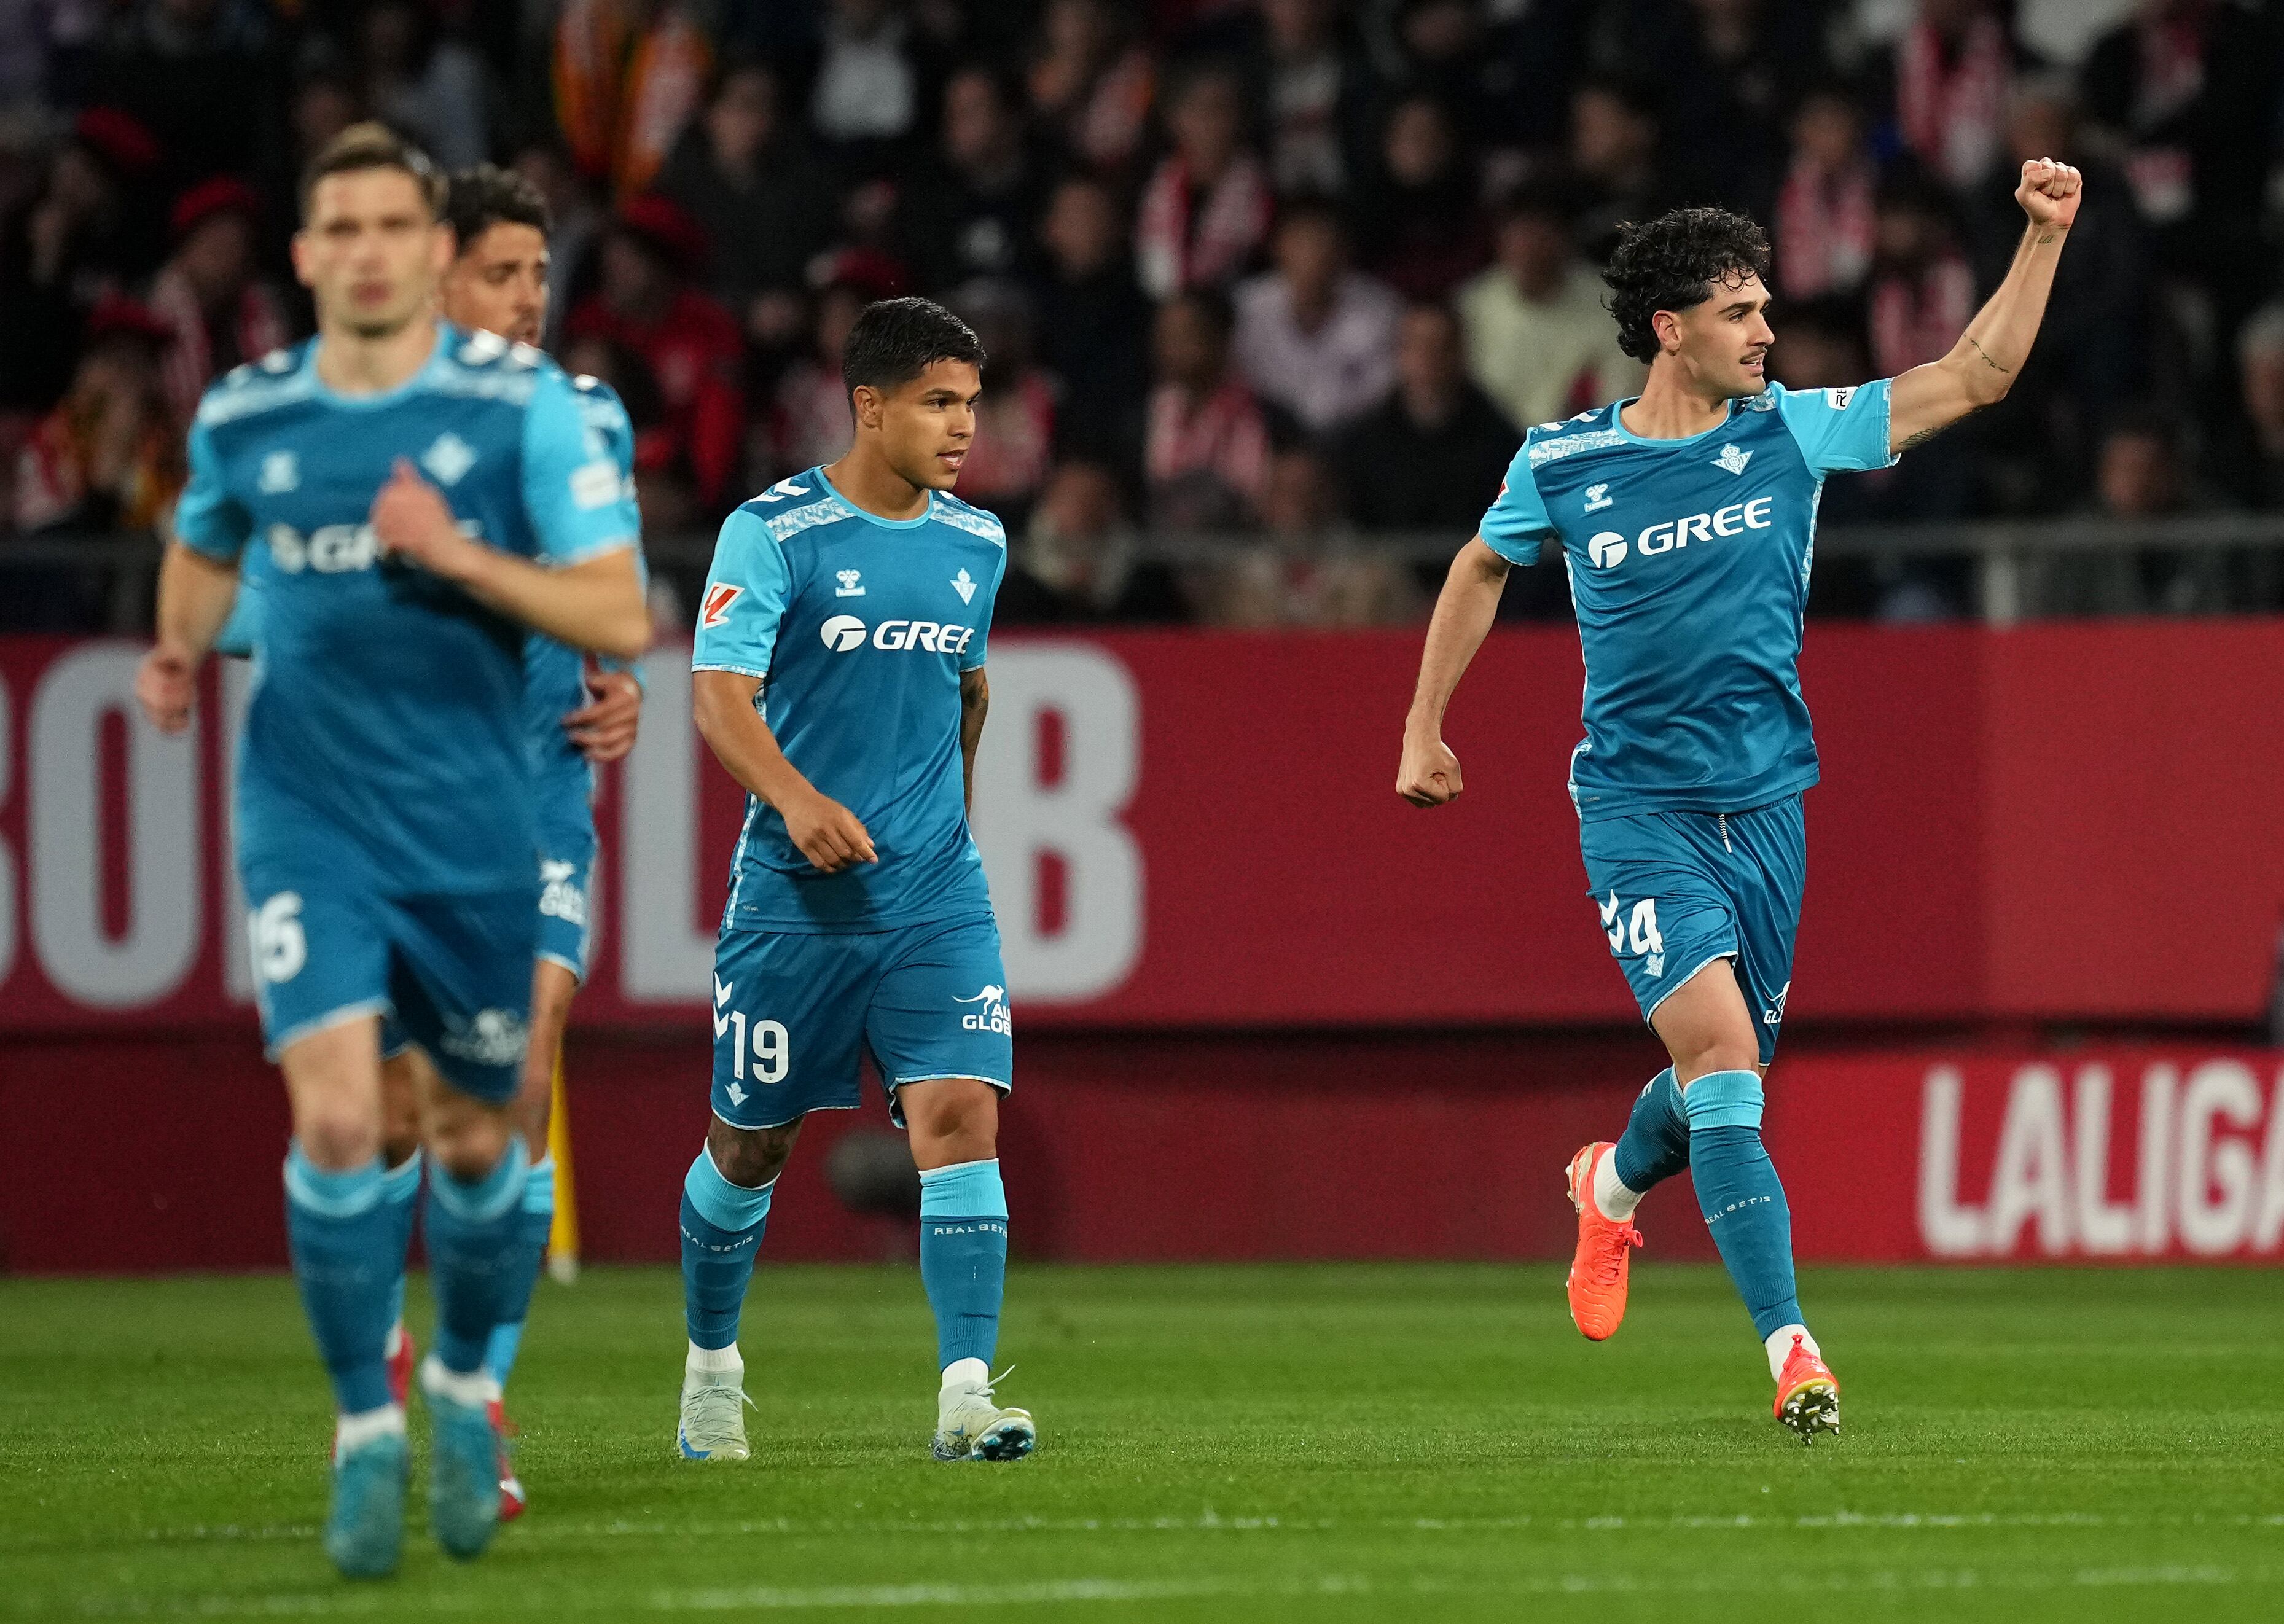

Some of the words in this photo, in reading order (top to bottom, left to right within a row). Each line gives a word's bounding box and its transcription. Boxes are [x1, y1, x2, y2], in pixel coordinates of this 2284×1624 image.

[1637, 496, 1772, 555] GREE
[872, 620, 975, 654] GREE
[730, 1010, 789, 1083] 19
[1705, 1210, 1726, 1225] REAL
[1727, 1195, 1771, 1212] BETIS
[711, 1235, 754, 1252] BETIS
[934, 1226, 976, 1235] REAL
